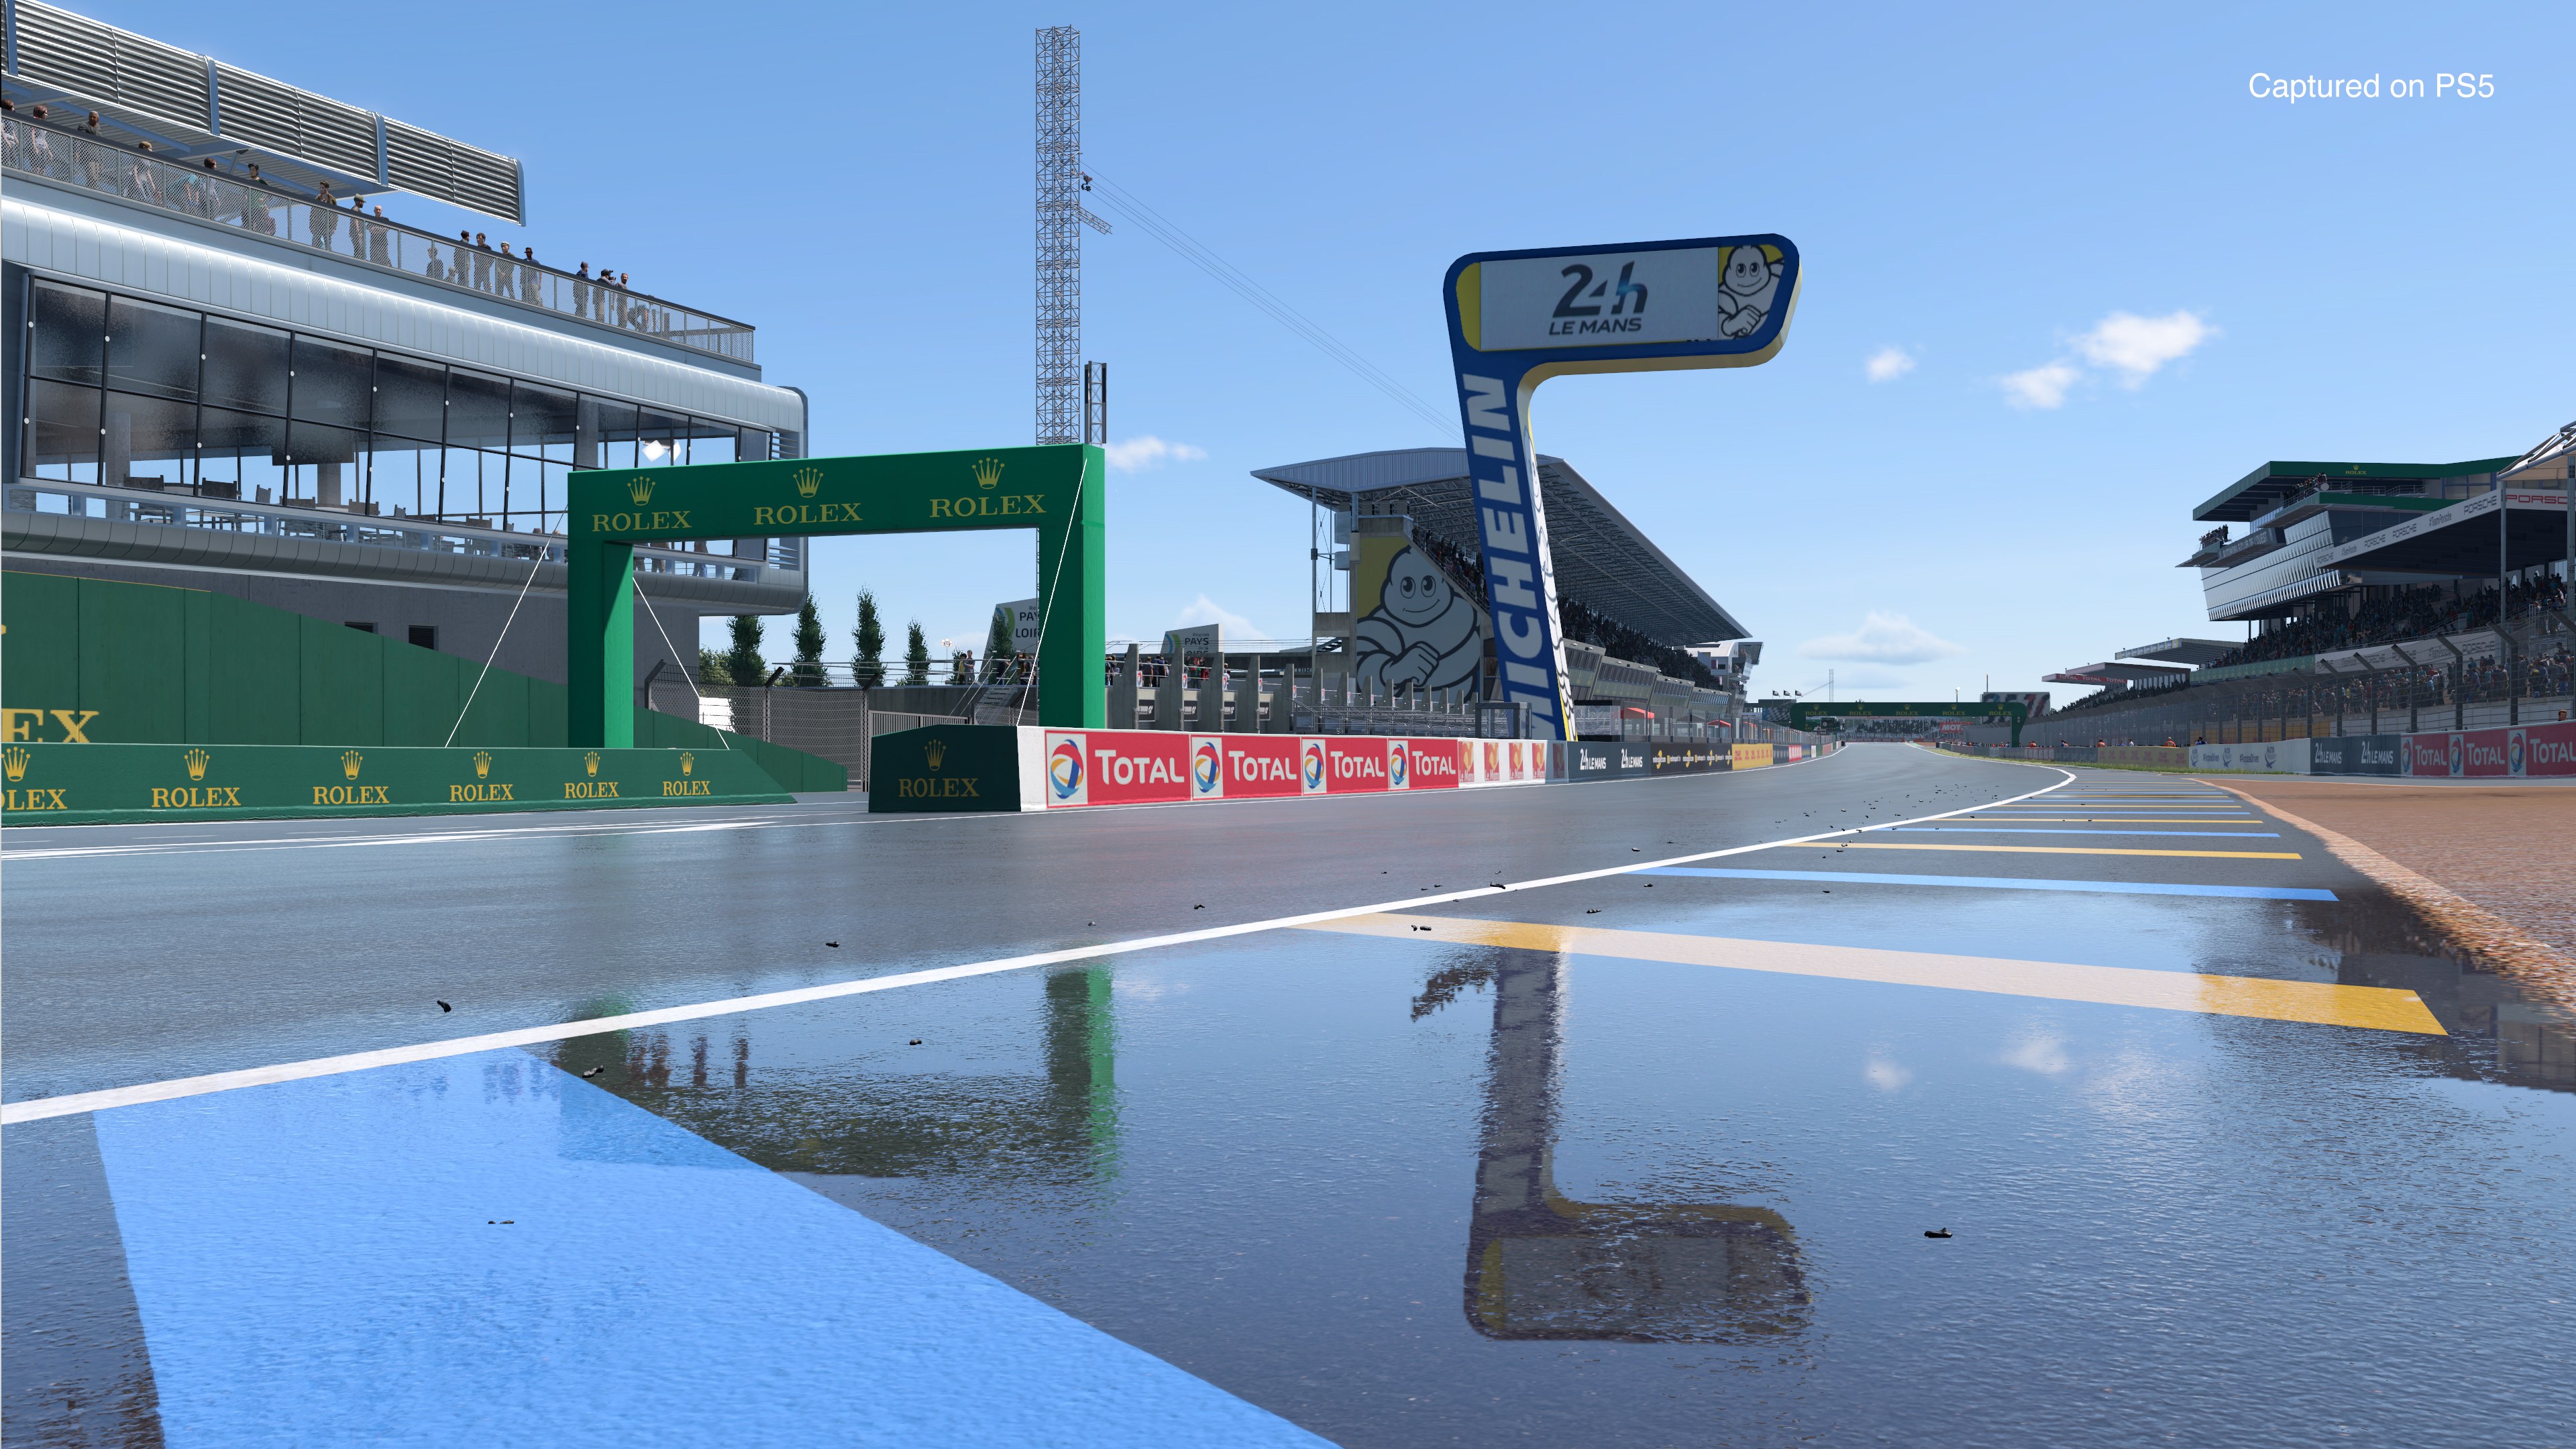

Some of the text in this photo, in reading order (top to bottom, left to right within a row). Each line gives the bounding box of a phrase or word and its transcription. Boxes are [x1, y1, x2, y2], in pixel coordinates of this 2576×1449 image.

[1552, 260, 1648, 319] 24h
[1548, 317, 1642, 336] LE MANS
[929, 494, 1047, 518] ROLEX
[2463, 495, 2497, 515] PORSCHE
[2506, 494, 2568, 504] PORSC
[592, 511, 693, 532] ROLEX
[753, 502, 863, 525] ROLEX
[2428, 511, 2452, 528] #TeamPorsche
[2392, 523, 2416, 539] PORSCHE
[2365, 534, 2385, 548] PORSCHE
[2317, 552, 2334, 564] PORSCHE
[1185, 637, 1209, 645] PAYS
[2239, 753, 2259, 765] #PurposeDriven
[2323, 751, 2329, 763] LE
[2329, 751, 2342, 764] MANS
[2371, 750, 2377, 764] LE
[2378, 750, 2394, 764] MANS
[2415, 745, 2447, 766] TOTAL
[2466, 743, 2506, 766] TOTAL
[2529, 738, 2576, 763] TOTAL
[1094, 749, 1185, 786] TOTAL
[1228, 750, 1297, 782] TOTAL
[1330, 751, 1385, 779] TOTAL
[1411, 751, 1456, 776] TOTAL
[1589, 757, 1595, 770] LE
[1595, 757, 1607, 769] MANS
[1629, 757, 1633, 768] LE
[1633, 756, 1643, 768] MANS
[1459, 769, 1474, 782] Le Mans
[1485, 769, 1499, 780] Le Mans
[1509, 768, 1523, 780] Le Mans
[1532, 767, 1546, 778] Le Mans
[313, 786, 390, 805] ROLEX
[449, 784, 515, 802] ROLEX
[564, 782, 619, 799] ROLEX
[662, 780, 711, 797] ROLEX
[898, 777, 980, 798] ROLEX
[1, 789, 68, 810] LEX
[151, 787, 241, 808] ROLEX
